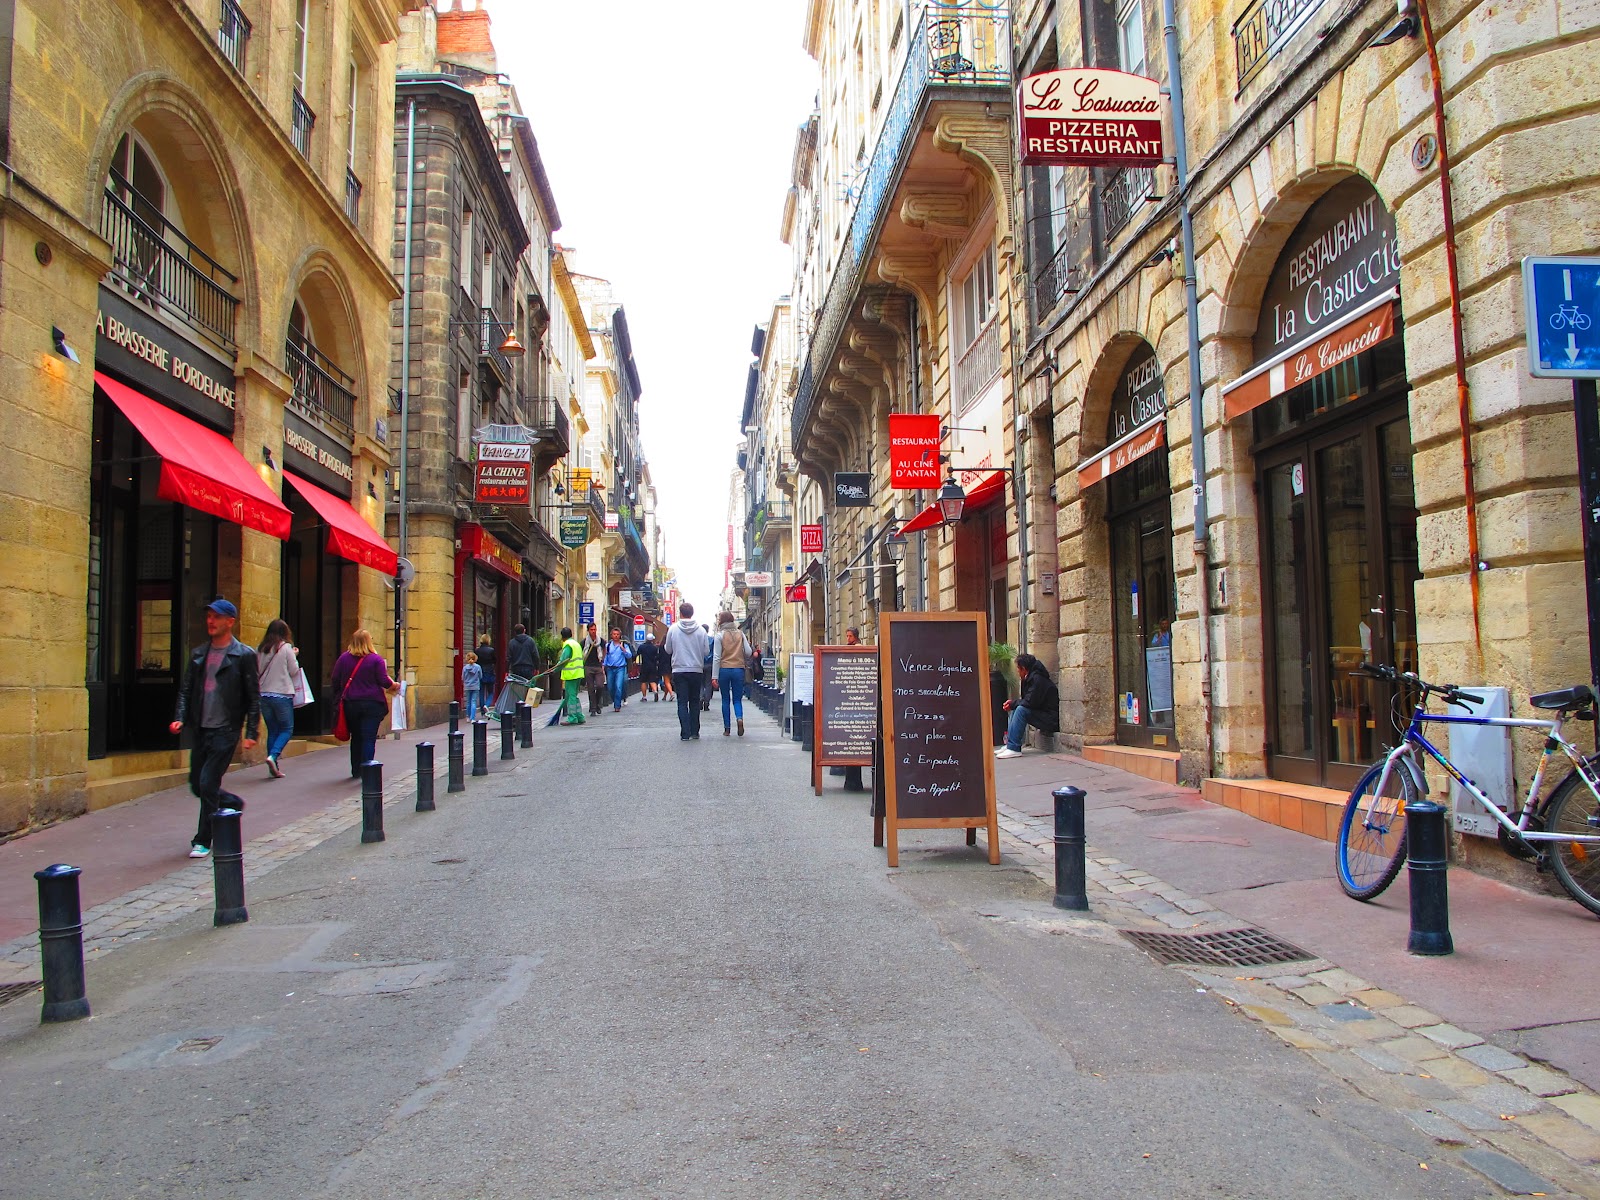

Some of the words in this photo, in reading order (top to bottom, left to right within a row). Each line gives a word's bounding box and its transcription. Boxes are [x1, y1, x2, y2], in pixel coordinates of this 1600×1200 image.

[1025, 78, 1063, 111] La
[1071, 78, 1160, 113] Casuccia
[1049, 121, 1139, 138] PIZZERIA
[1028, 138, 1161, 155] RESTAURANT
[1289, 193, 1378, 291] RESTAURANT
[1273, 303, 1297, 346] La
[1303, 229, 1402, 326] Casuccia
[95, 309, 105, 335] A
[106, 315, 170, 372] BRASSERIE
[172, 355, 236, 410] BORDELAISE
[1294, 353, 1314, 383] La
[1317, 321, 1382, 370] Casuccia
[1114, 409, 1127, 439] La
[286, 427, 318, 461] BRASSERIE
[892, 437, 939, 446] RESTAURANT
[898, 460, 911, 468] AU
[913, 458, 934, 468] CINÉ
[1116, 449, 1126, 470] La
[480, 467, 493, 476] LA
[494, 467, 526, 477] CHINE
[895, 469, 937, 478] D'ANTAN
[508, 478, 528, 486] chinois
[802, 531, 821, 545] PIZZA
[900, 654, 934, 674] Venez
[895, 688, 914, 696] nos
[904, 706, 945, 720] Pizzas
[918, 754, 959, 770] Emporter
[908, 784, 926, 794] Bon
[1463, 816, 1478, 832] EDF
